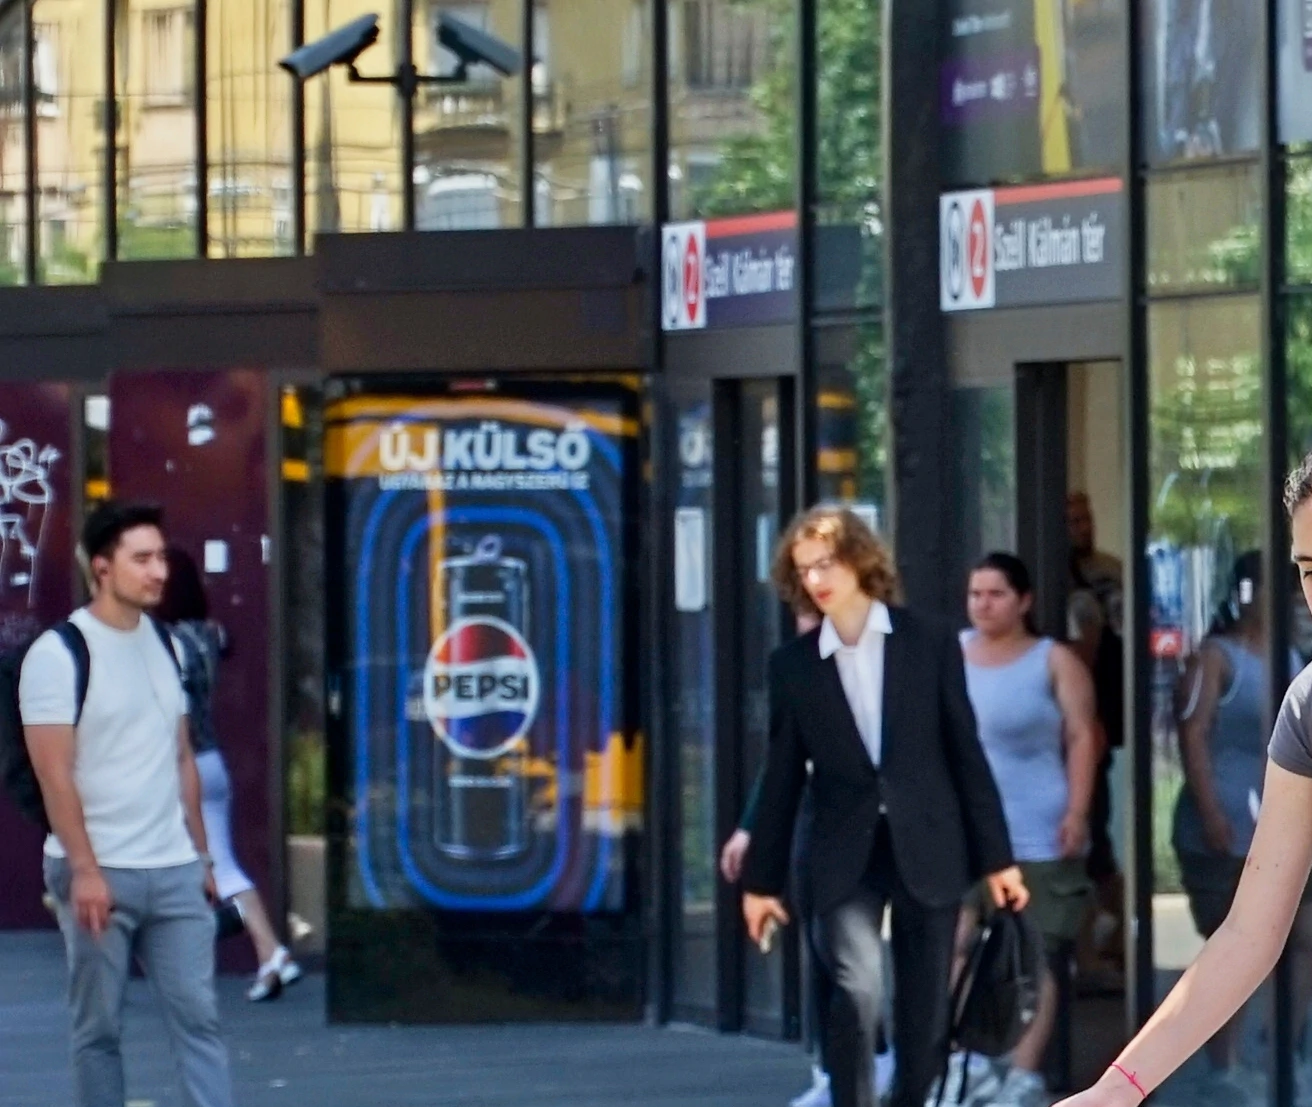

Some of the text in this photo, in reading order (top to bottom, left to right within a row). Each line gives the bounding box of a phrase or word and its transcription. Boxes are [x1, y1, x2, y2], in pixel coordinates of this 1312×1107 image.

[969, 210, 1105, 278] 2 Széll Kálmán tér
[379, 419, 591, 471] ÚJ KÜLSŐ
[432, 674, 530, 701] PEPSI
